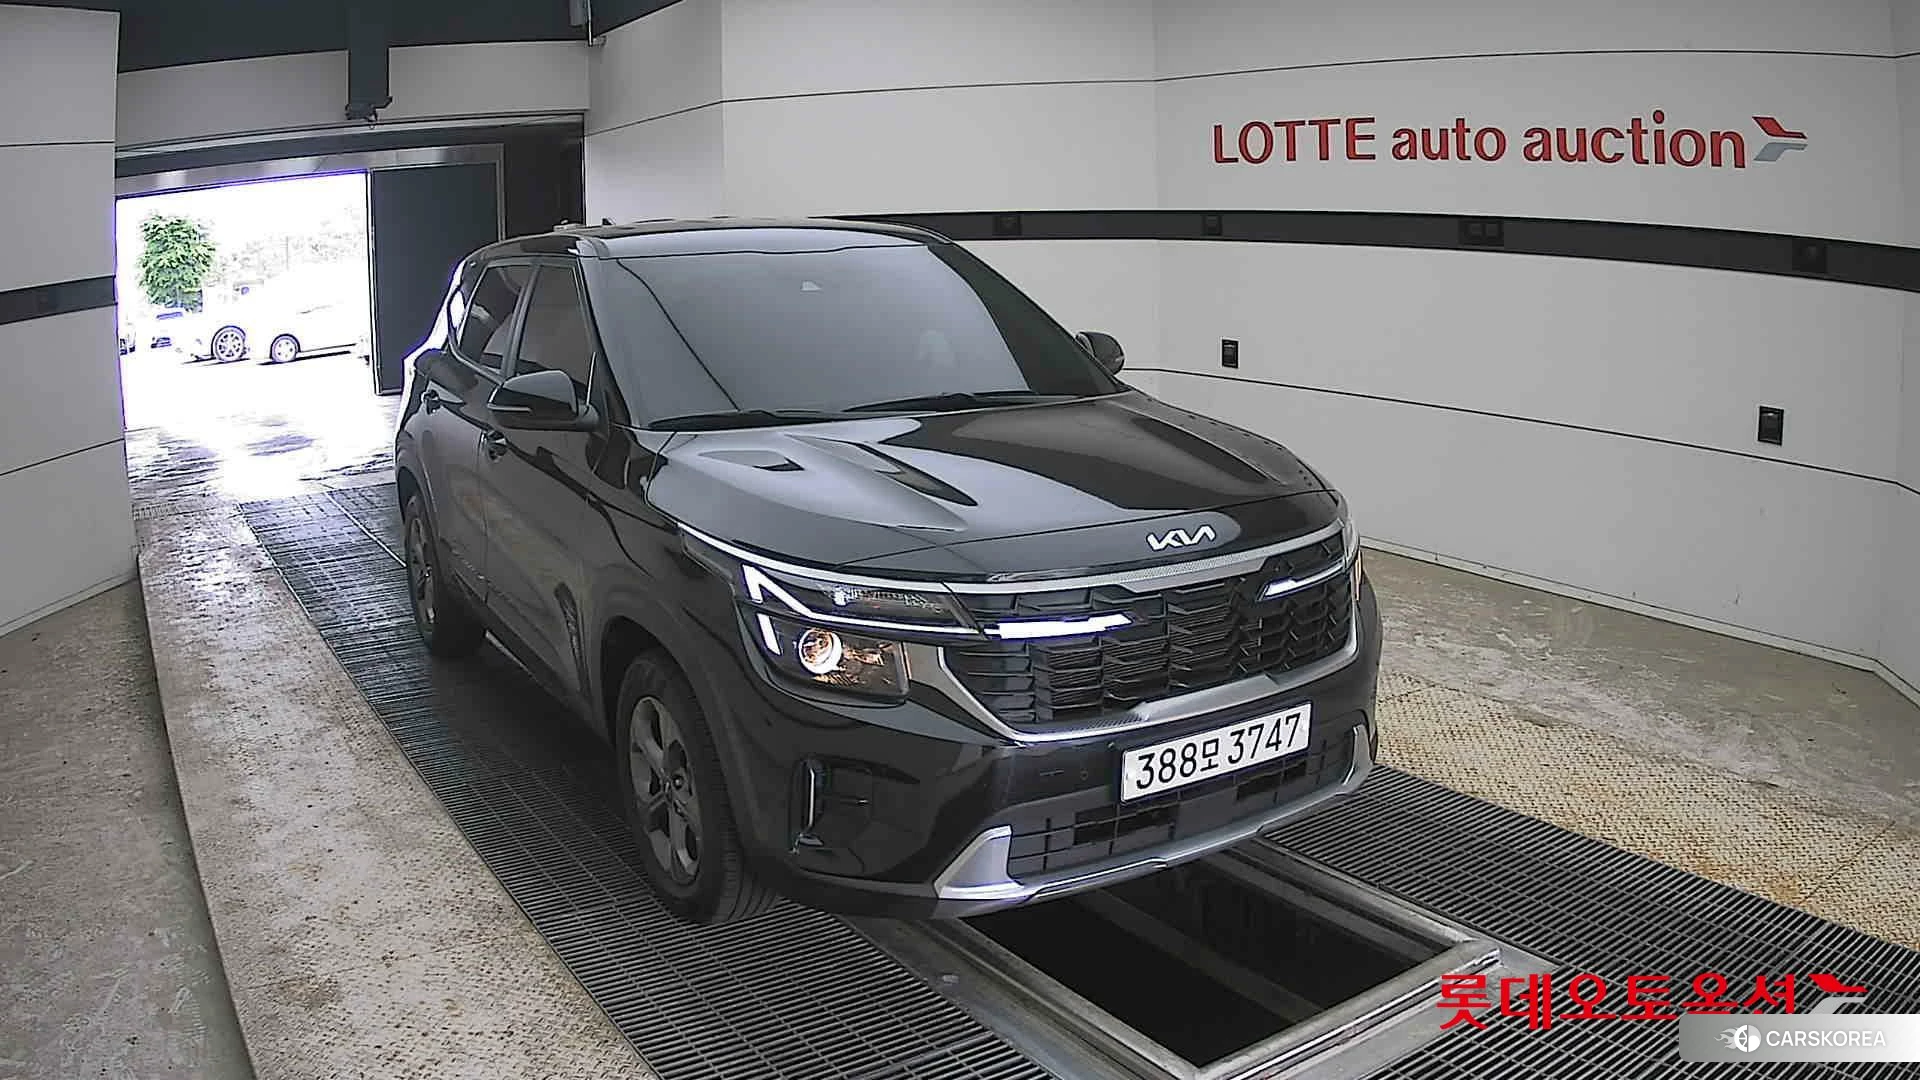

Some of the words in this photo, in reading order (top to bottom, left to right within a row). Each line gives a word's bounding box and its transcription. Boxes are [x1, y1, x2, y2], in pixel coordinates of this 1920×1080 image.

[1213, 117, 1376, 164] LOTTE
[1392, 117, 1507, 162] auto
[1522, 110, 1746, 169] auction
[1146, 524, 1217, 551] KIA
[1136, 738, 1220, 789] 388모
[1227, 712, 1301, 765] 3747
